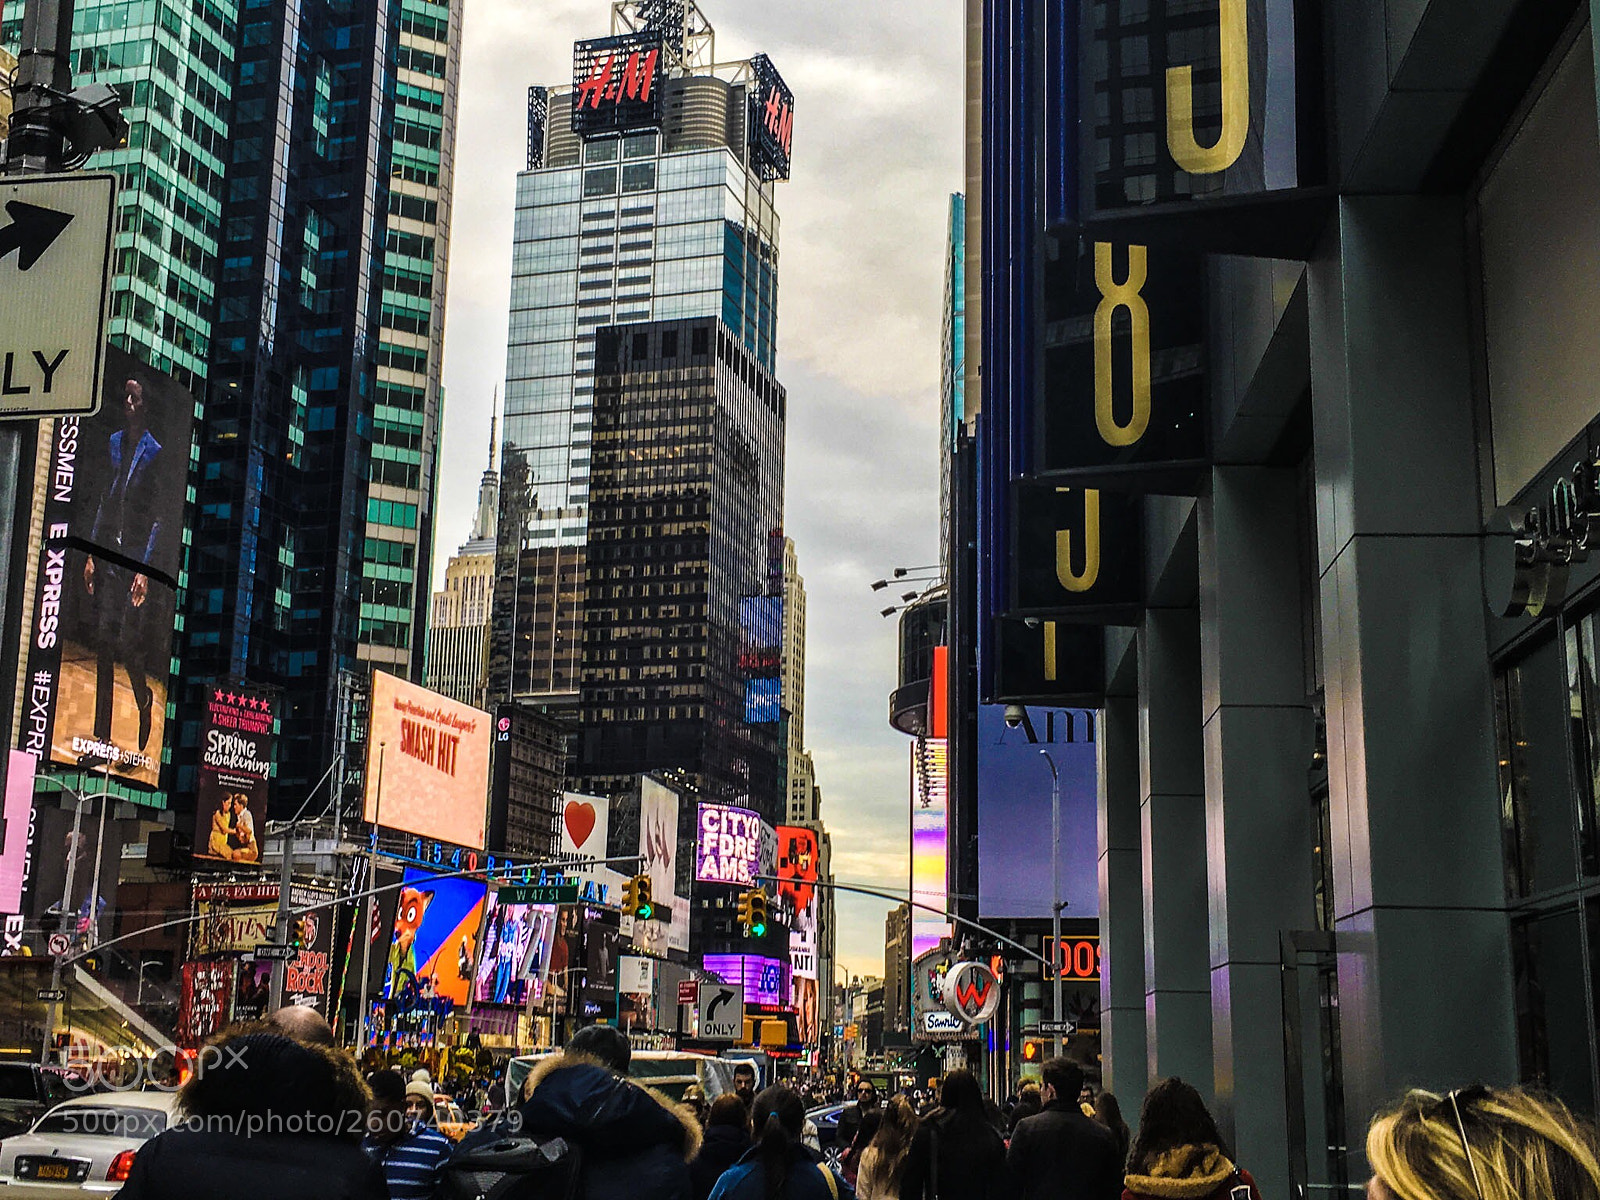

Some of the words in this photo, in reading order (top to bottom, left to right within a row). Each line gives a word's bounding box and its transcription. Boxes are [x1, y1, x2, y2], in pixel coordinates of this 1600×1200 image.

[578, 48, 659, 111] H&M
[763, 84, 793, 157] H&M
[207, 729, 257, 759] SPRING
[400, 717, 436, 767] SMASH
[437, 730, 460, 778] HIT
[498, 732, 509, 741] LG
[204, 749, 270, 781] awakening
[415, 838, 478, 872] 1540
[198, 886, 207, 897] A
[233, 885, 256, 897] FAT
[516, 889, 526, 901] W
[530, 889, 544, 901] 47
[548, 888, 559, 901] St
[1052, 941, 1100, 977] DO
[285, 967, 326, 995] ROCK
[956, 978, 993, 1008] W
[704, 1023, 737, 1036] ONLY
